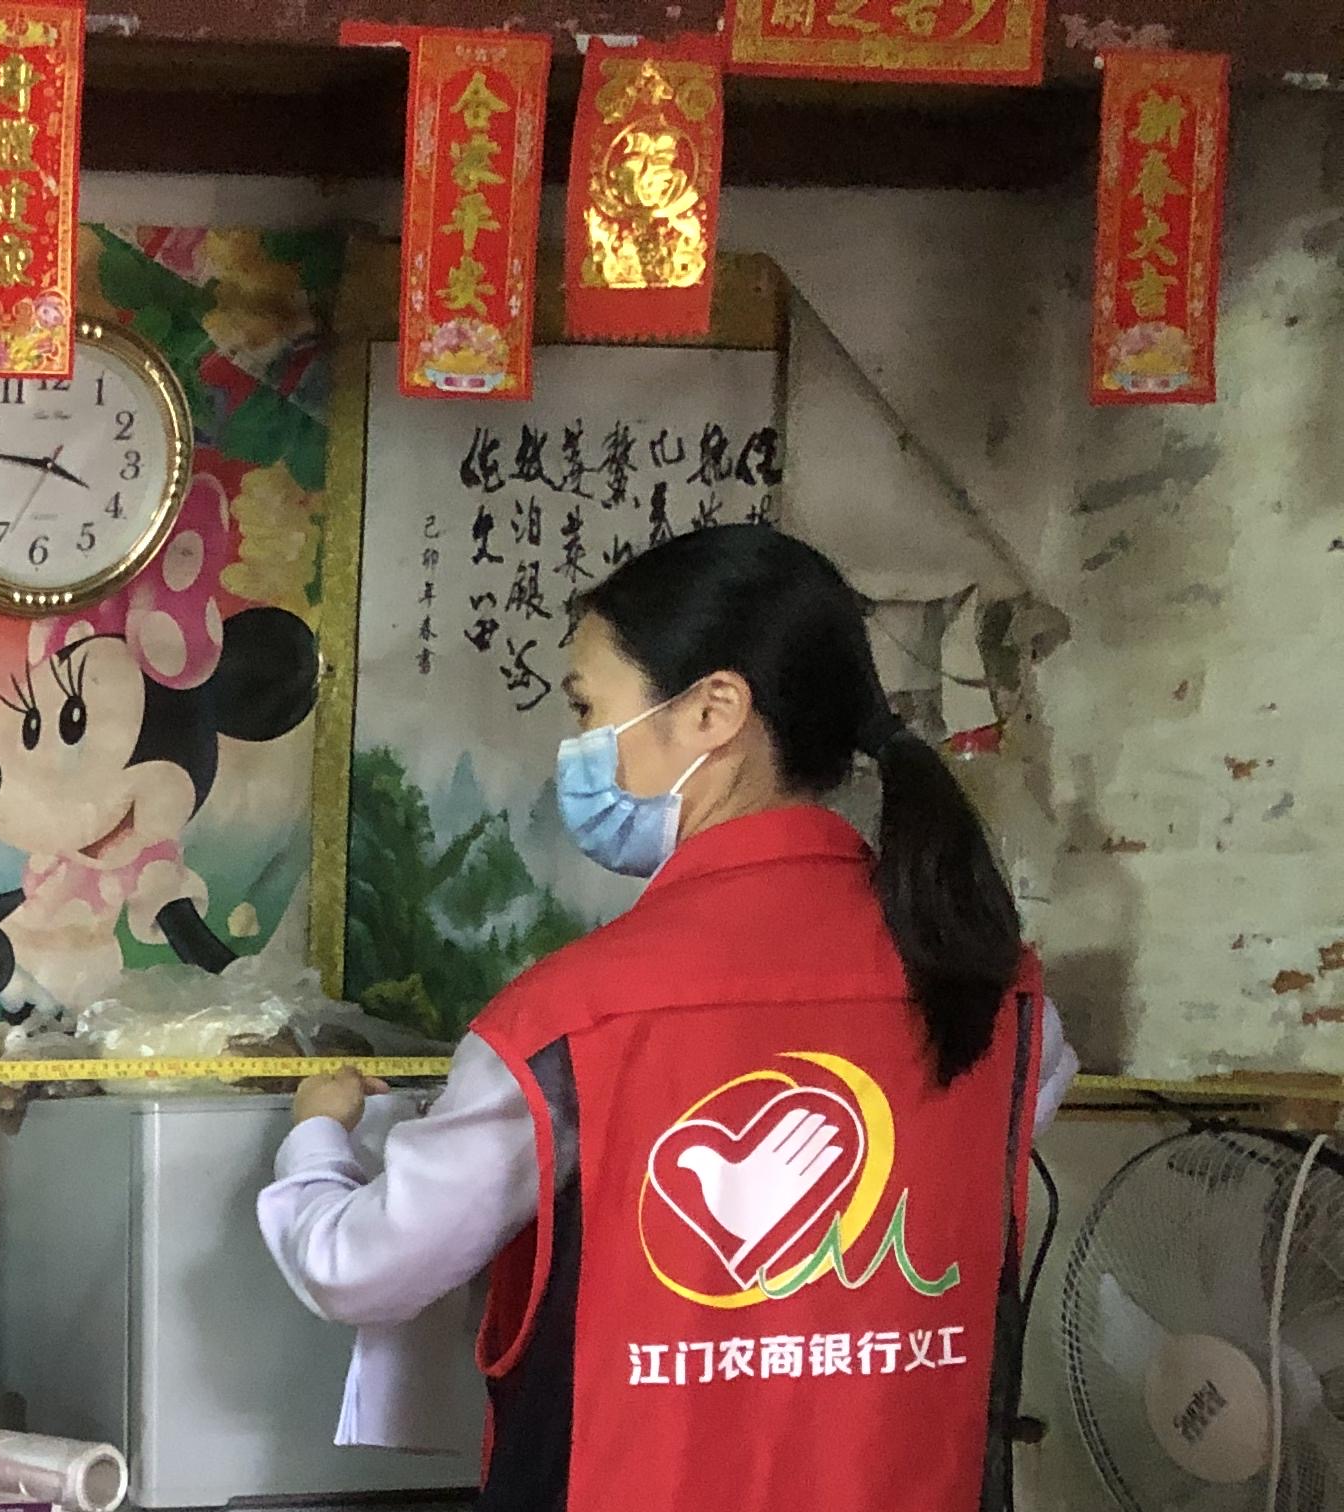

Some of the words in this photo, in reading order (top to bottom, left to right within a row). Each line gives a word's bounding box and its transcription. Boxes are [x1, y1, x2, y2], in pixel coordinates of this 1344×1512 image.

[436, 70, 512, 316] 合家平安
[1124, 88, 1189, 318] 新春大吉
[0, 378, 26, 405] 11
[95, 376, 105, 406] 1
[114, 410, 135, 441] 2
[119, 450, 142, 480] 3
[104, 491, 124, 519] 4
[28, 535, 49, 565] 6
[76, 522, 96, 551] 5
[628, 1326, 967, 1386] 江门农商银行义工
